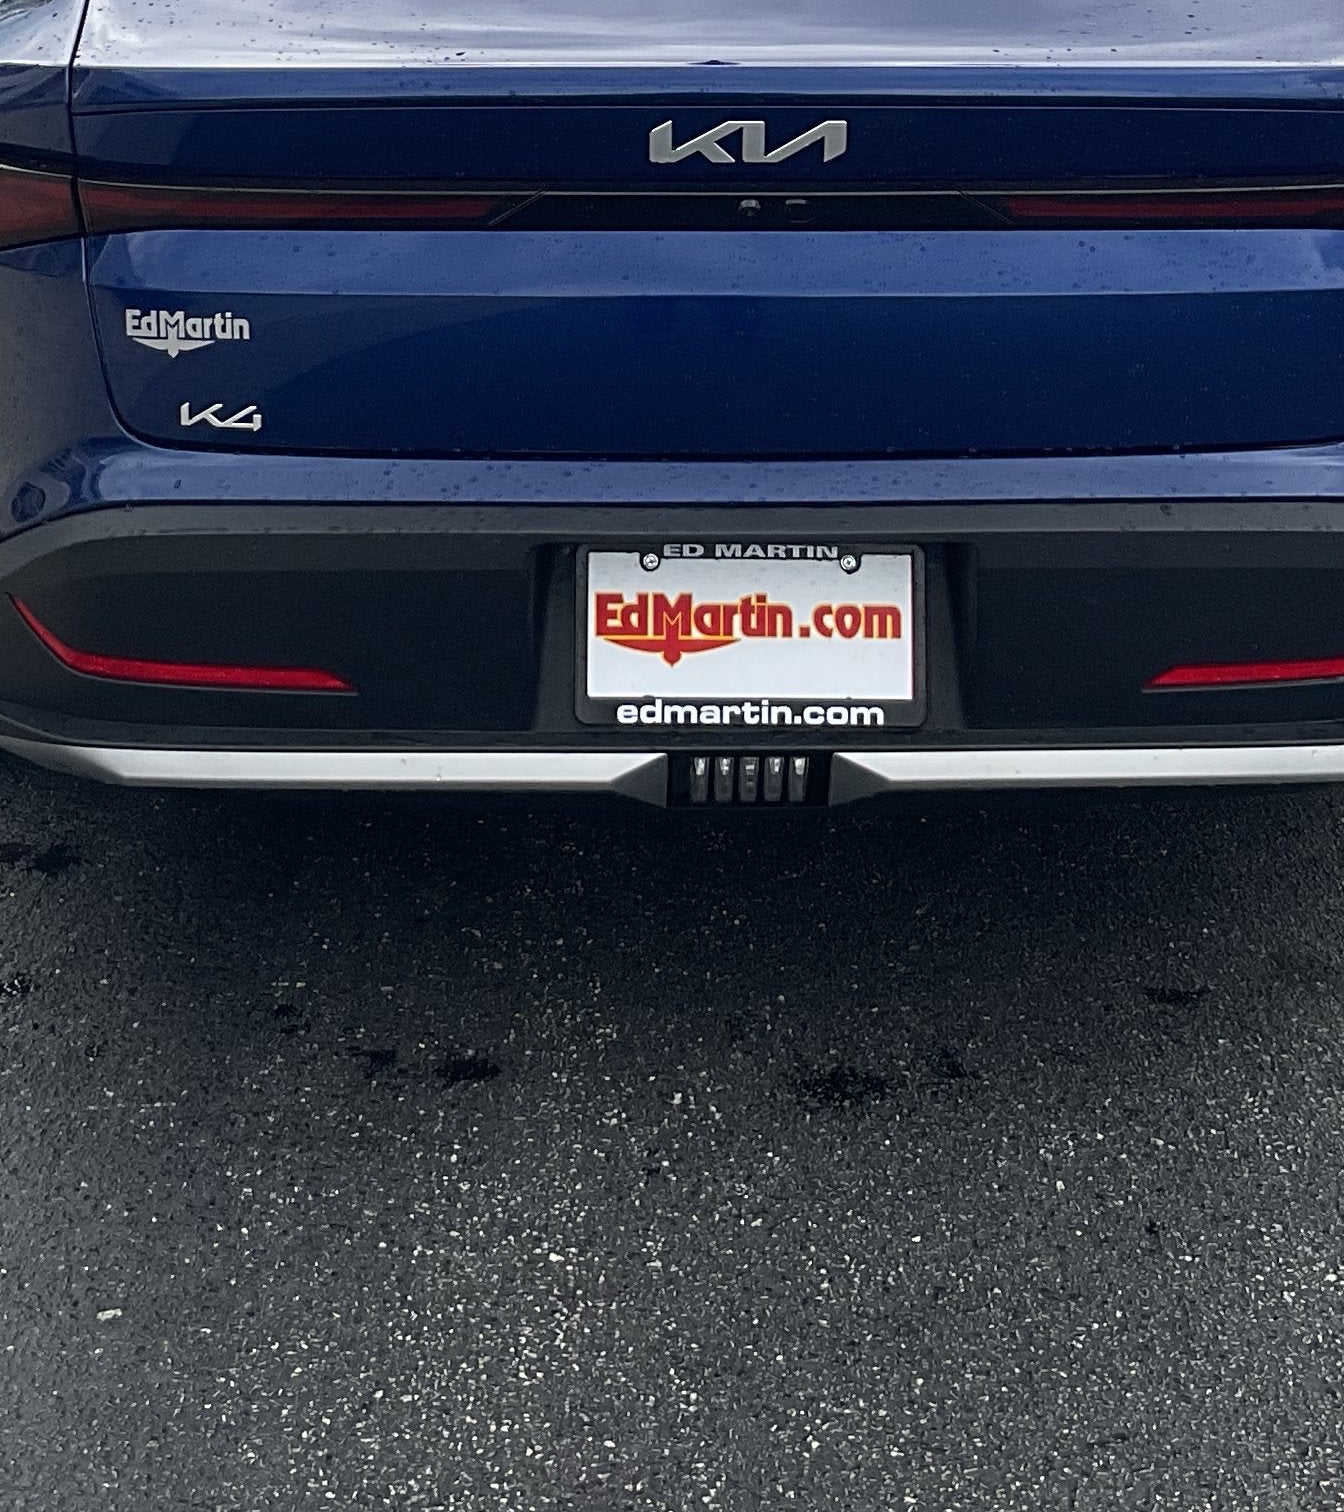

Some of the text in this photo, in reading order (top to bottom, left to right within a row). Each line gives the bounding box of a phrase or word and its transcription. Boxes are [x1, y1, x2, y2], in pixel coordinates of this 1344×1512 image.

[649, 119, 848, 163] KIA
[125, 308, 251, 340] EdMartin
[180, 402, 262, 432] K4
[663, 544, 839, 559] ED MARTIN
[594, 592, 903, 640] EdMartin.com
[616, 699, 885, 726] edmartin.com
